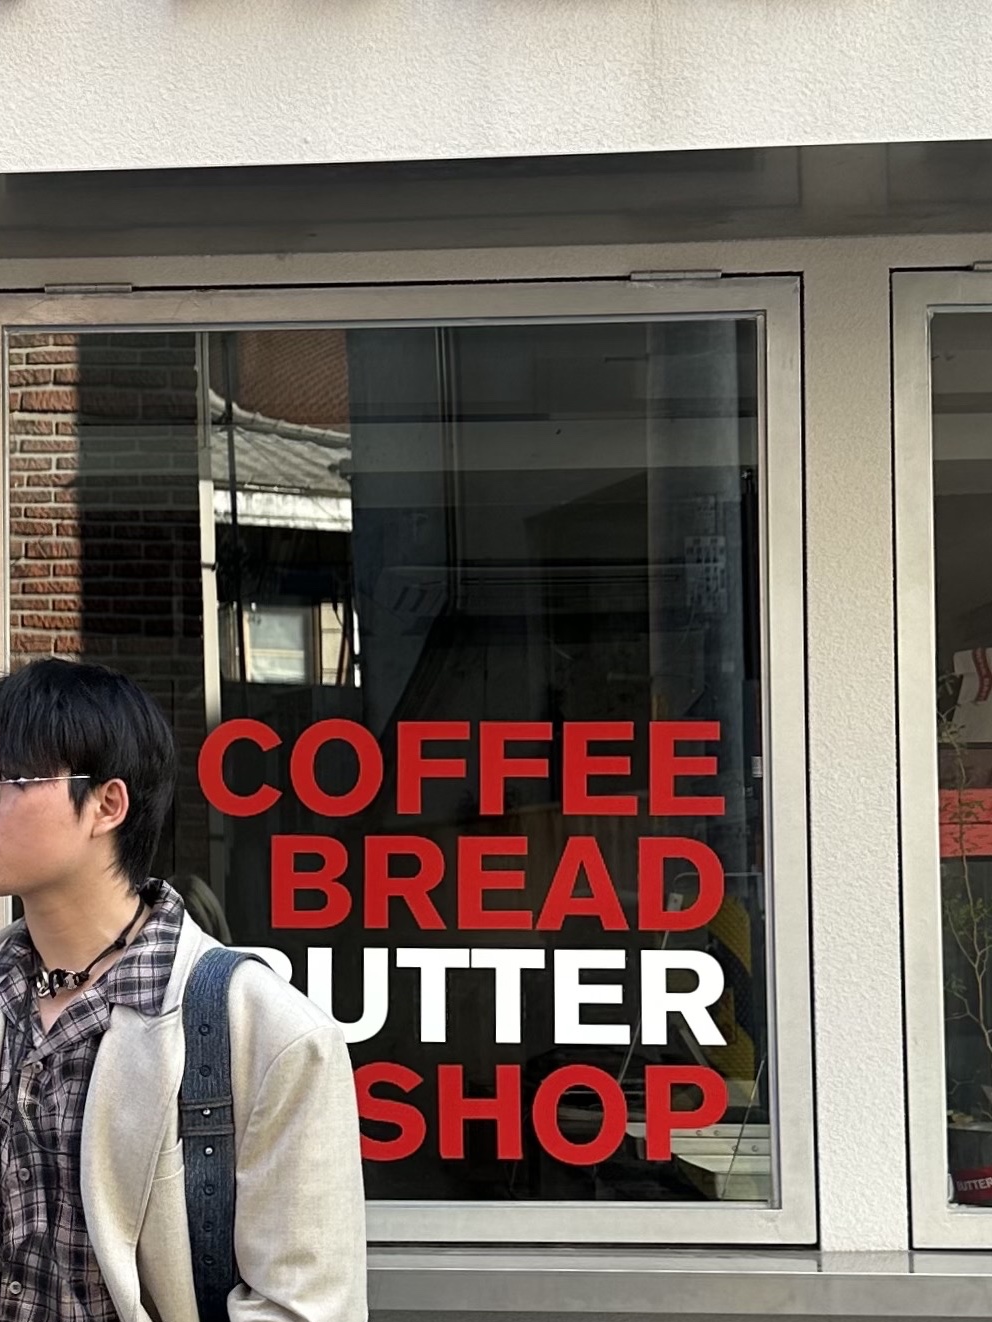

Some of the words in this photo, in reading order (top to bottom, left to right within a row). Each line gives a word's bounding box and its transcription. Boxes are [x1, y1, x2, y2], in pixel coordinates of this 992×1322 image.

[199, 718, 724, 818] COFFEE
[271, 834, 724, 931] BREAD
[357, 1062, 728, 1166] SHOP
